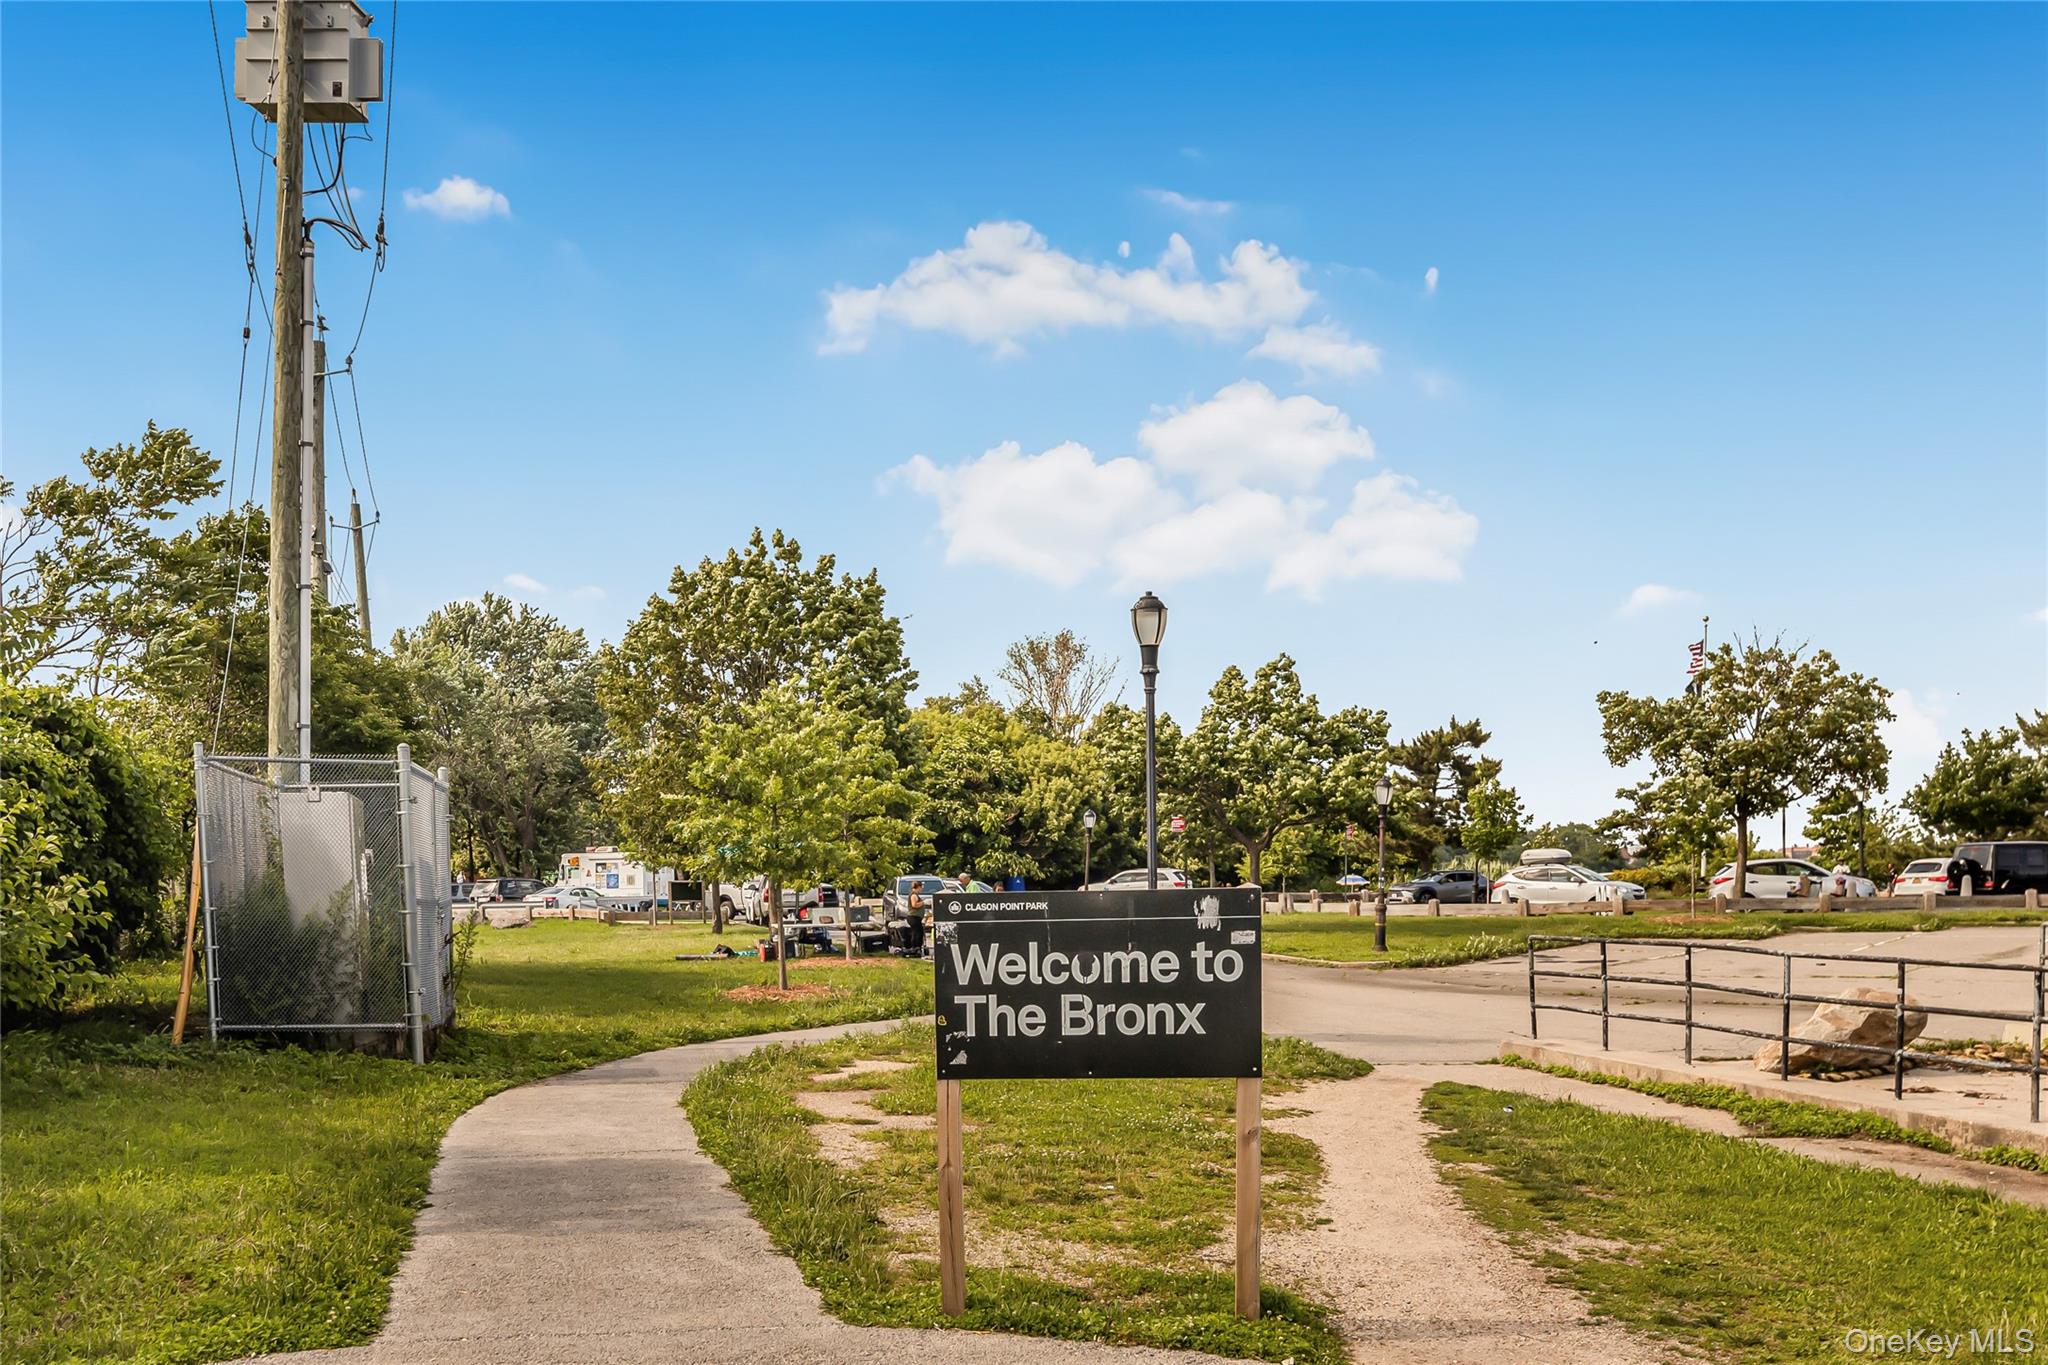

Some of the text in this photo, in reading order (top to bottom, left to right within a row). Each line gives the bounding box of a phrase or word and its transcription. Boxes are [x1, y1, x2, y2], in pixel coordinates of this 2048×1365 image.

[965, 902, 1048, 911] CLASON POINT PARK
[950, 941, 1244, 985] Welcome to
[954, 994, 1206, 1037] The Bronx
